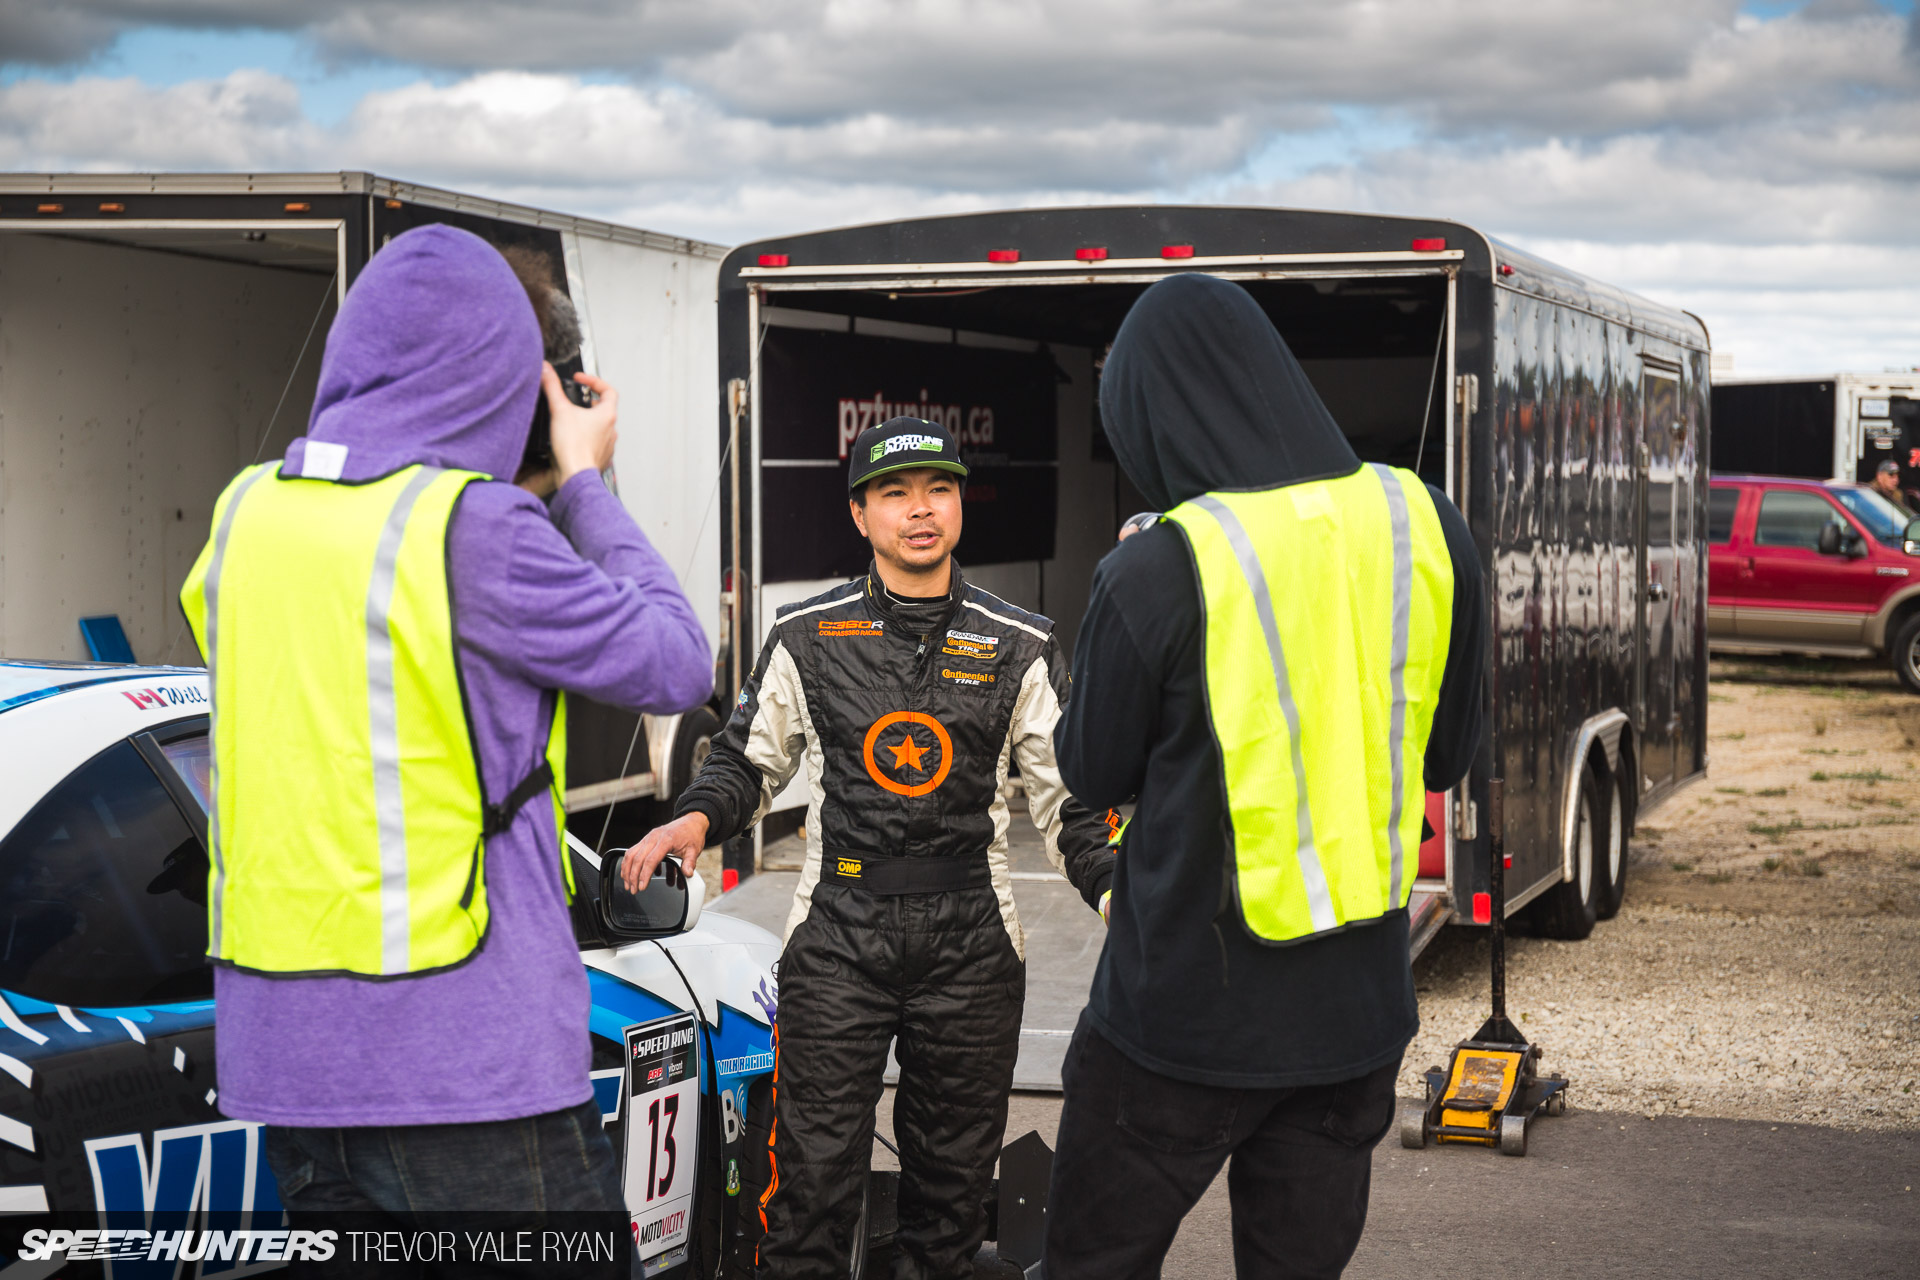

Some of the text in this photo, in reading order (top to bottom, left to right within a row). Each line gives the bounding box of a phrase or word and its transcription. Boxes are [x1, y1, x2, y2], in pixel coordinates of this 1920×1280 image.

[885, 434, 944, 447] FORTUNE
[884, 442, 921, 455] AUTO
[818, 620, 884, 630] C360R
[947, 637, 988, 650] Continental
[942, 668, 988, 682] Continental
[157, 686, 207, 705] Will
[838, 861, 862, 874] OMP
[637, 1033, 670, 1058] SPEED
[671, 1027, 694, 1048] RING
[739, 1053, 773, 1072] RACING
[647, 1067, 663, 1080] ARP
[646, 1093, 679, 1202] 13
[640, 1209, 686, 1246] MOTOVICITY
